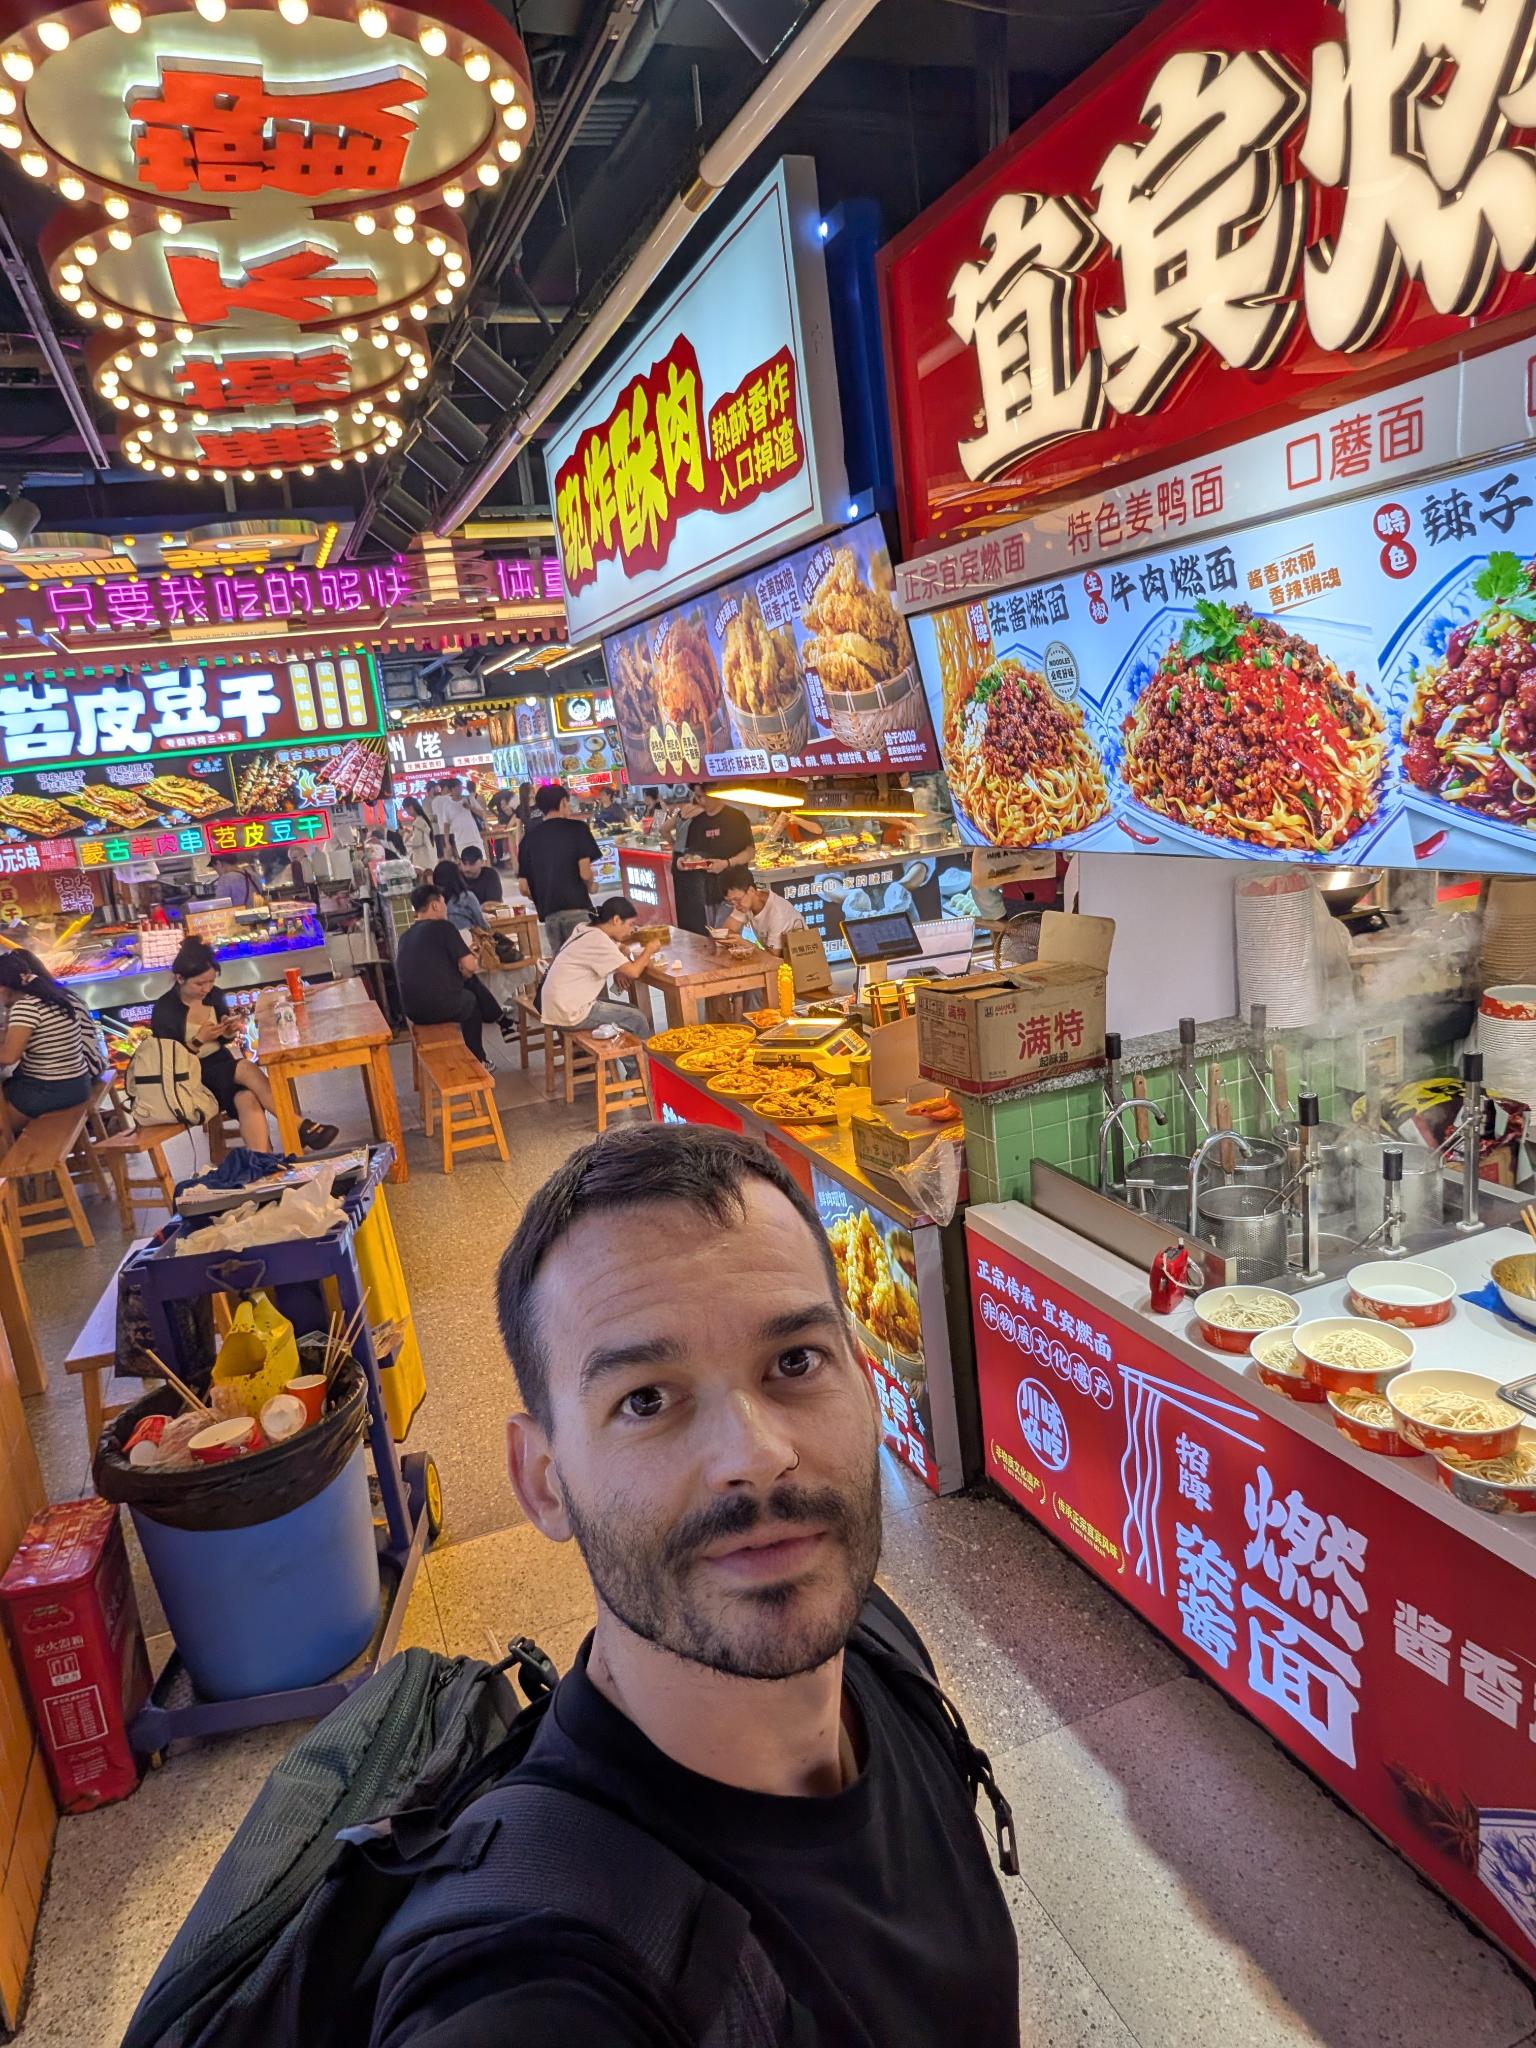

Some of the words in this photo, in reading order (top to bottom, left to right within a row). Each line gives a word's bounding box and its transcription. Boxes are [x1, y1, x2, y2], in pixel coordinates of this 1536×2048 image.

[711, 362, 790, 461] 热酥香炸
[1286, 396, 1424, 489] 口蘑面
[557, 362, 704, 580] 现炸酥肉
[1067, 465, 1224, 557] 特色姜鸭面
[1377, 509, 1409, 572] 特色
[48, 567, 411, 630] 只要我吃的够快
[904, 533, 1025, 604] 正宗宜宾燃面
[1085, 574, 1108, 621] 生椒
[1109, 545, 1238, 613] 牛肉燃面
[1247, 549, 1317, 591] 酱香浓郁
[1269, 567, 1342, 607] 香辣销魂
[969, 605, 990, 643] 招牌
[988, 583, 1070, 636] 杂酱燃面
[1049, 656, 1071, 667] NOODLES
[0, 668, 281, 763] 苕皮豆干
[277, 746, 342, 763] 蒙古羊肉串
[80, 829, 204, 866] 蒙古羊肉串
[213, 816, 325, 849] 苕皮豆干
[947, 1004, 967, 1022] 满特
[1017, 1008, 1085, 1060] 满特
[1039, 1051, 1069, 1069] 起酥油
[977, 1259, 1038, 1313] 正宗传承
[1041, 1298, 1113, 1362] 宜宾燃面
[983, 1300, 1112, 1399] 非物质文化遗产
[883, 1358, 926, 1437] WELCOME
[1176, 1431, 1213, 1512] 招牌
[1176, 1521, 1237, 1669] 杂酱
[1241, 1465, 1369, 1770] 燃面
[1393, 1599, 1536, 1744] 酱香
